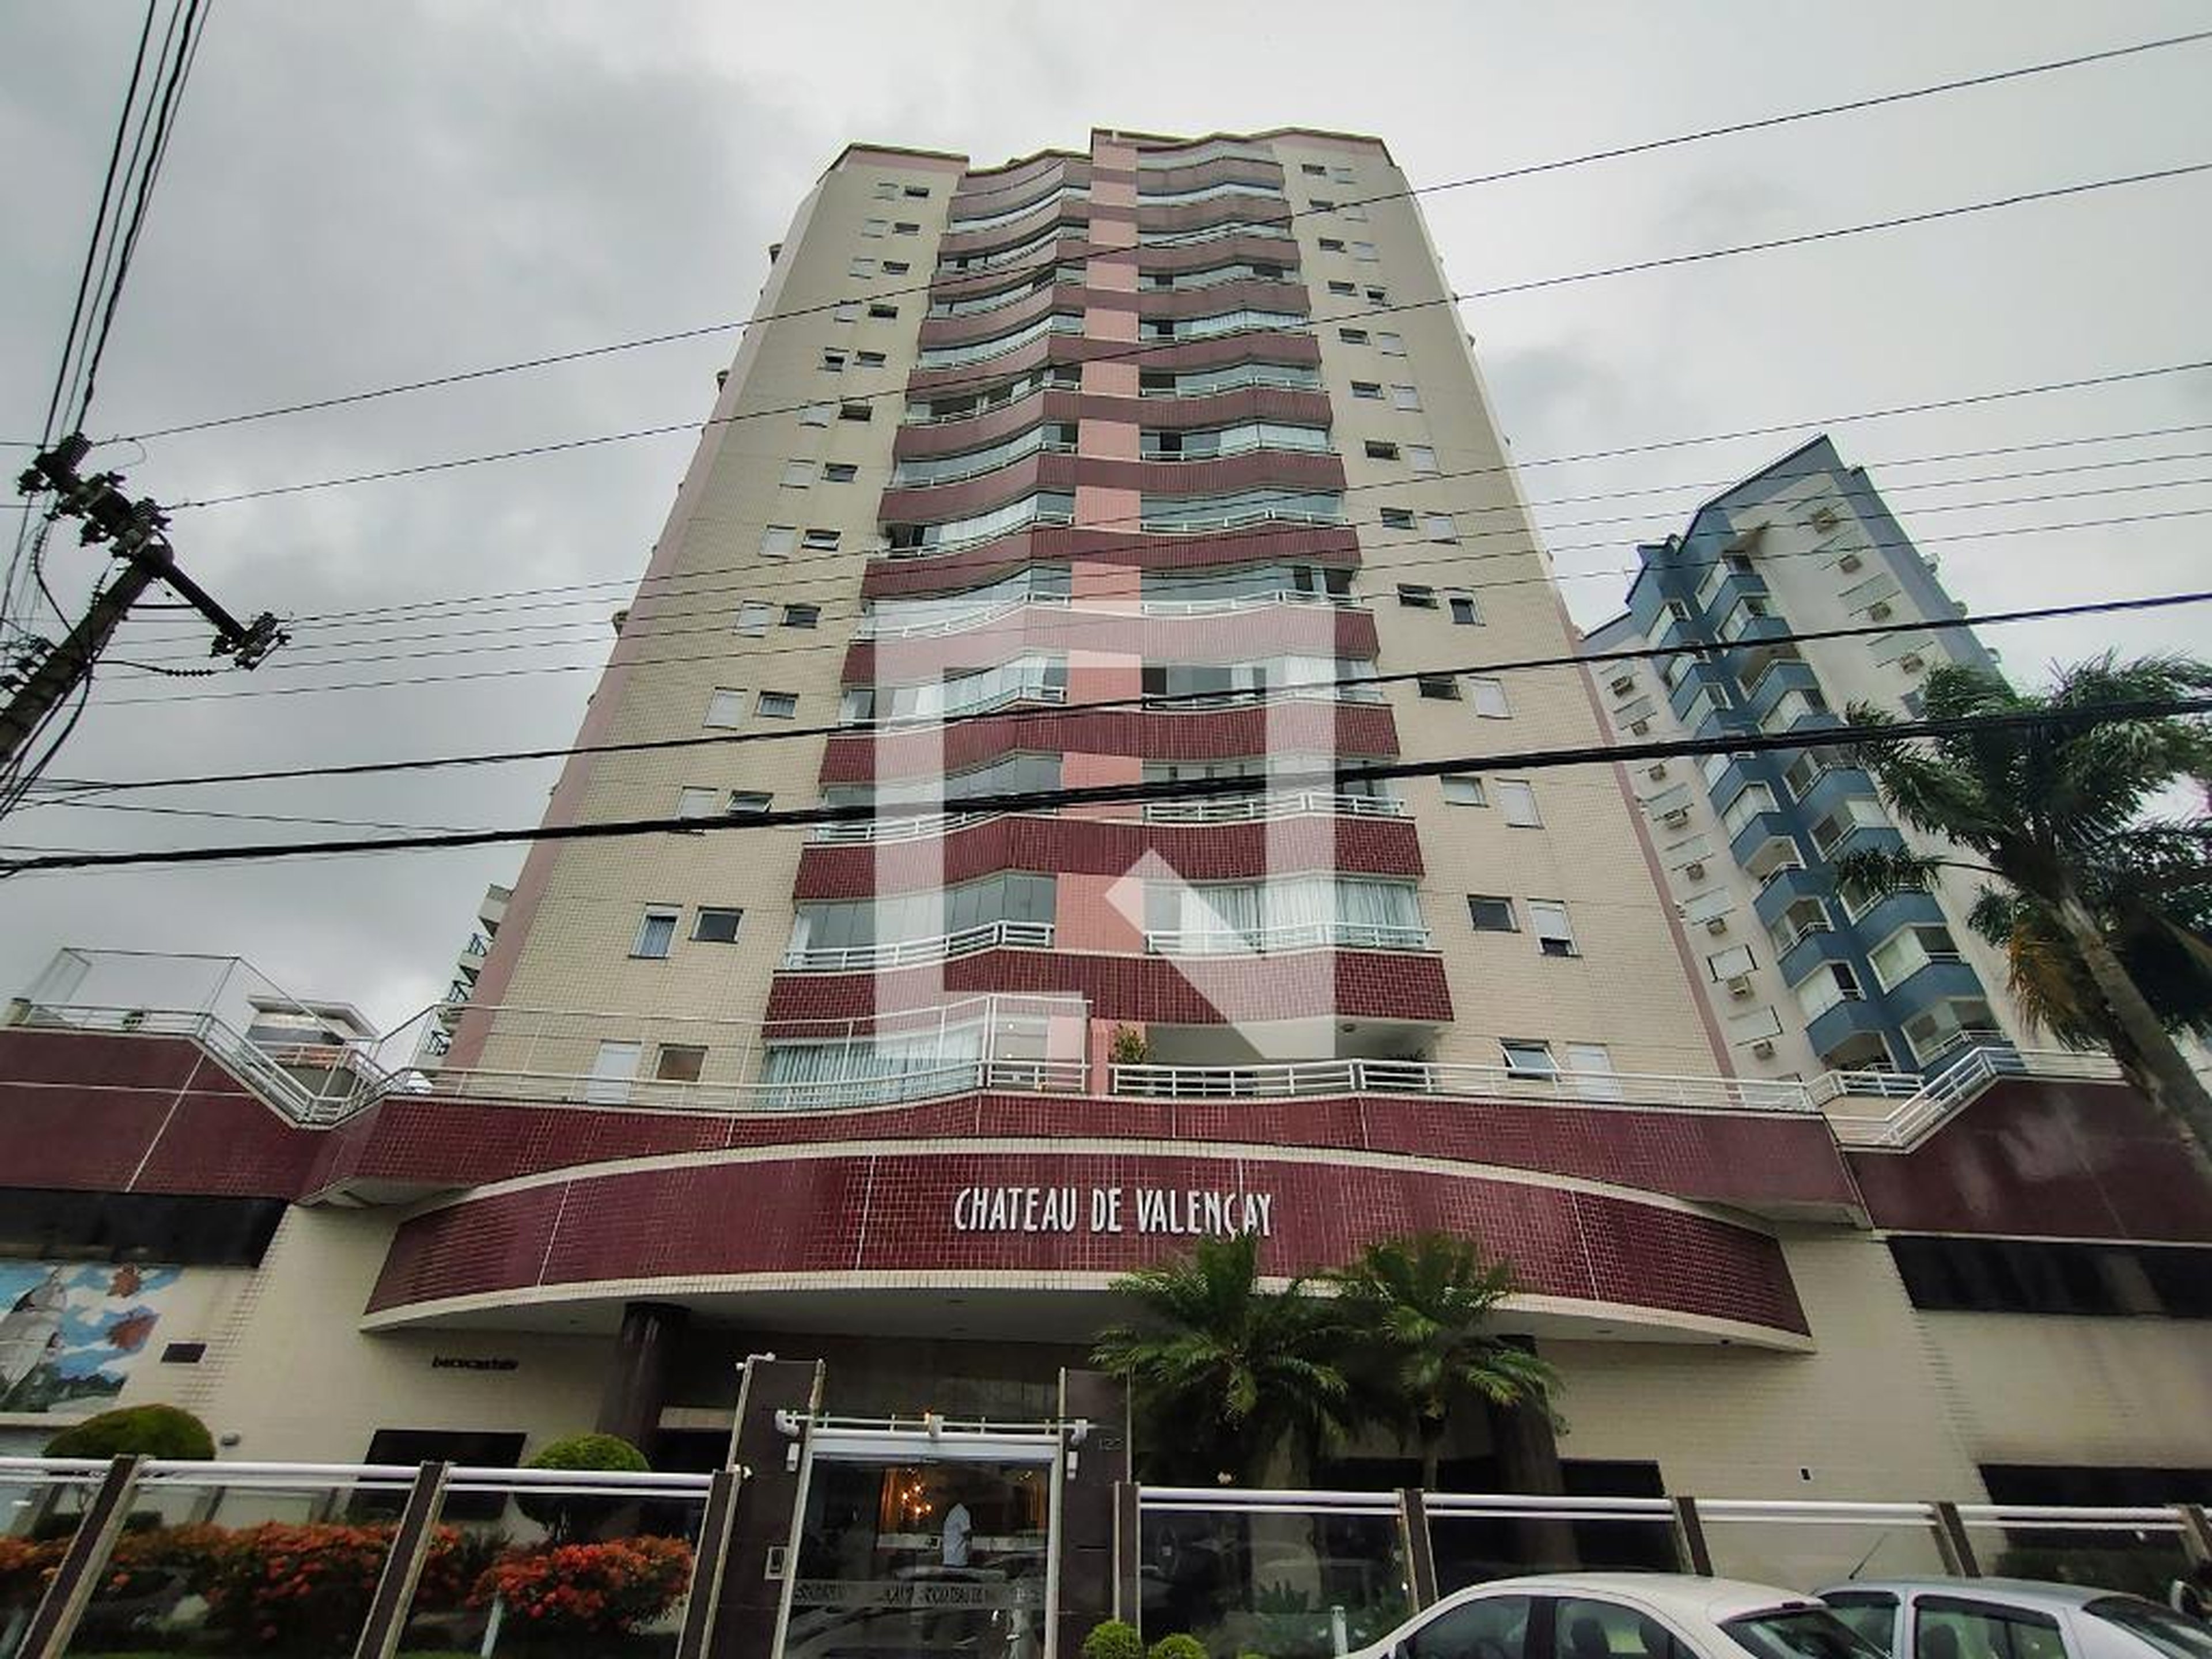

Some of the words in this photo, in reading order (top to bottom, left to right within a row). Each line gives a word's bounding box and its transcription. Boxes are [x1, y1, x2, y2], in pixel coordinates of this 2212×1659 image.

[954, 1187, 1077, 1231] CHATEAU
[1091, 1188, 1123, 1232] DE
[1137, 1190, 1272, 1239] VALENÇAY
